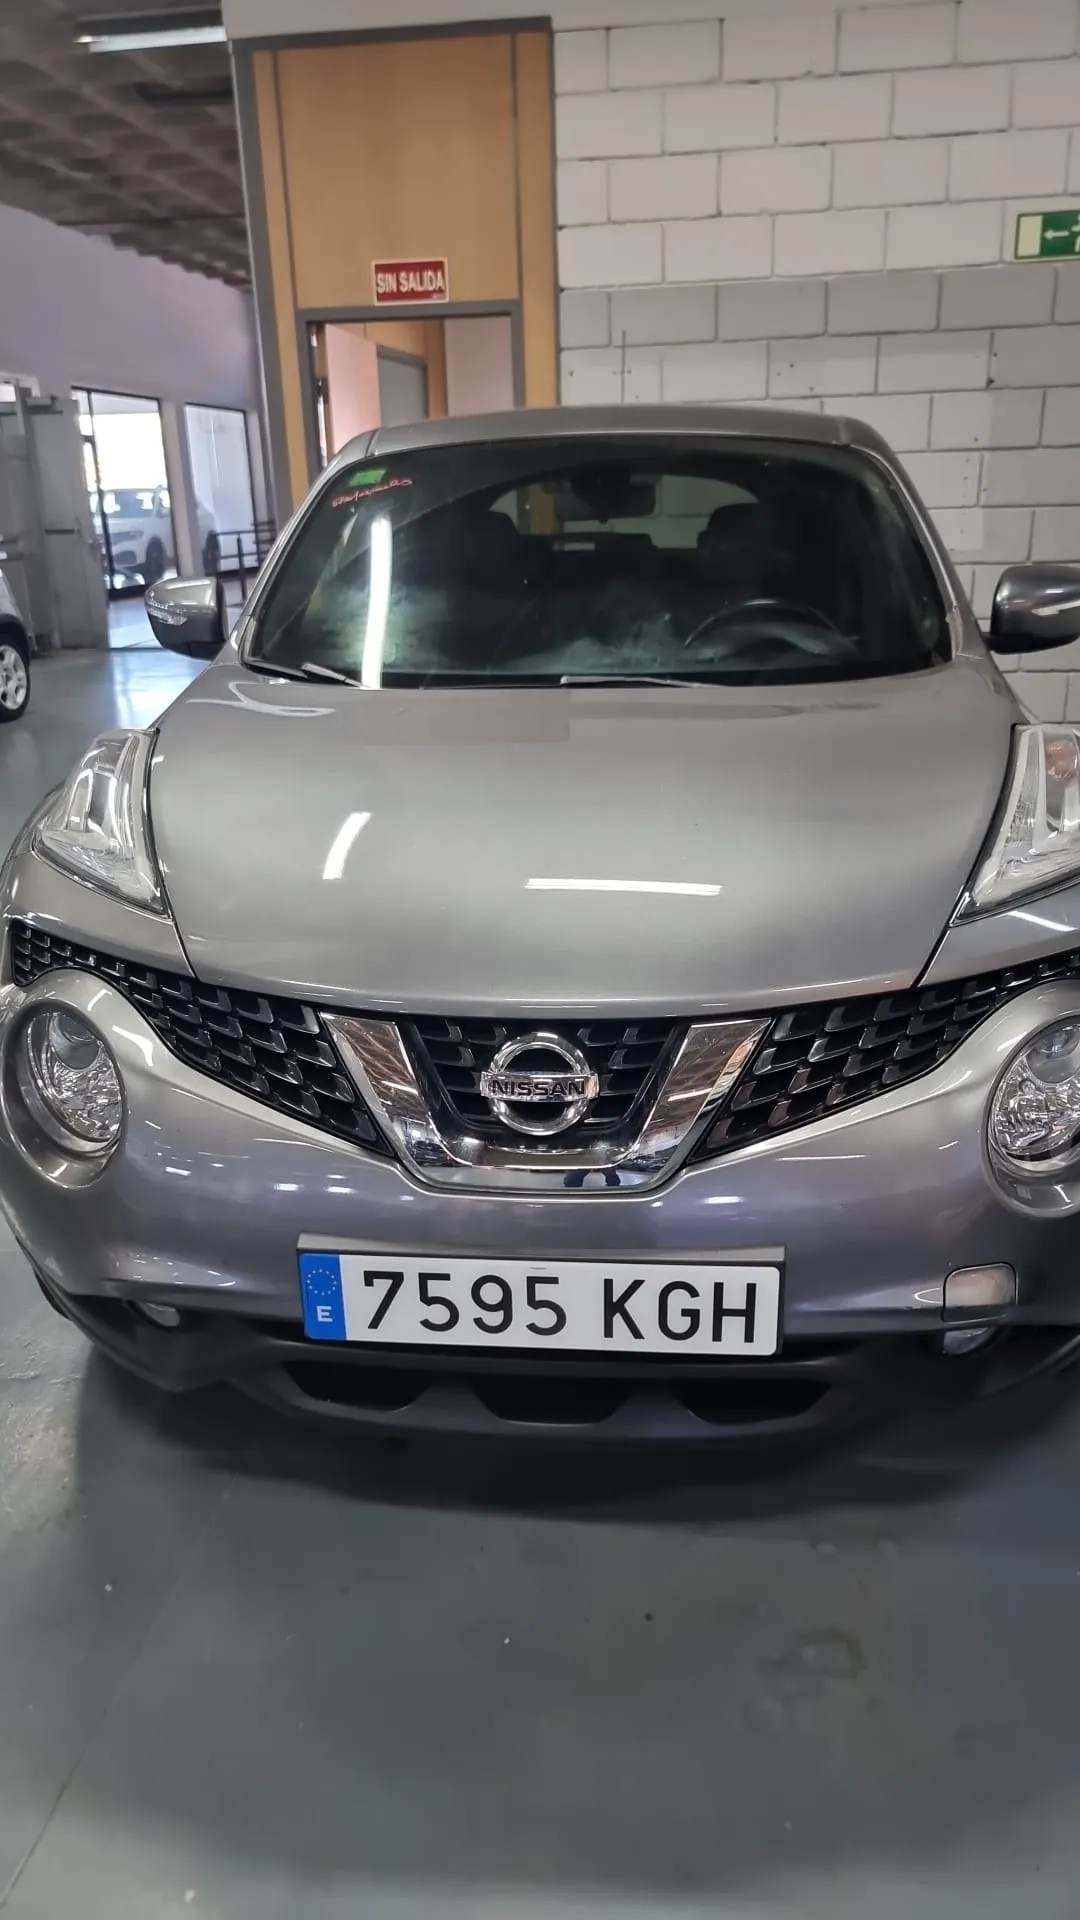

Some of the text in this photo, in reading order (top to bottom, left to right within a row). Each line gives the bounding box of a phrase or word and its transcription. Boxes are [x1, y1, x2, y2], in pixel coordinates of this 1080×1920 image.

[377, 269, 445, 294] SIN SALIDA
[491, 1079, 586, 1097] NISSAN
[316, 1305, 333, 1323] E
[363, 1270, 757, 1343] 7595 KGH
